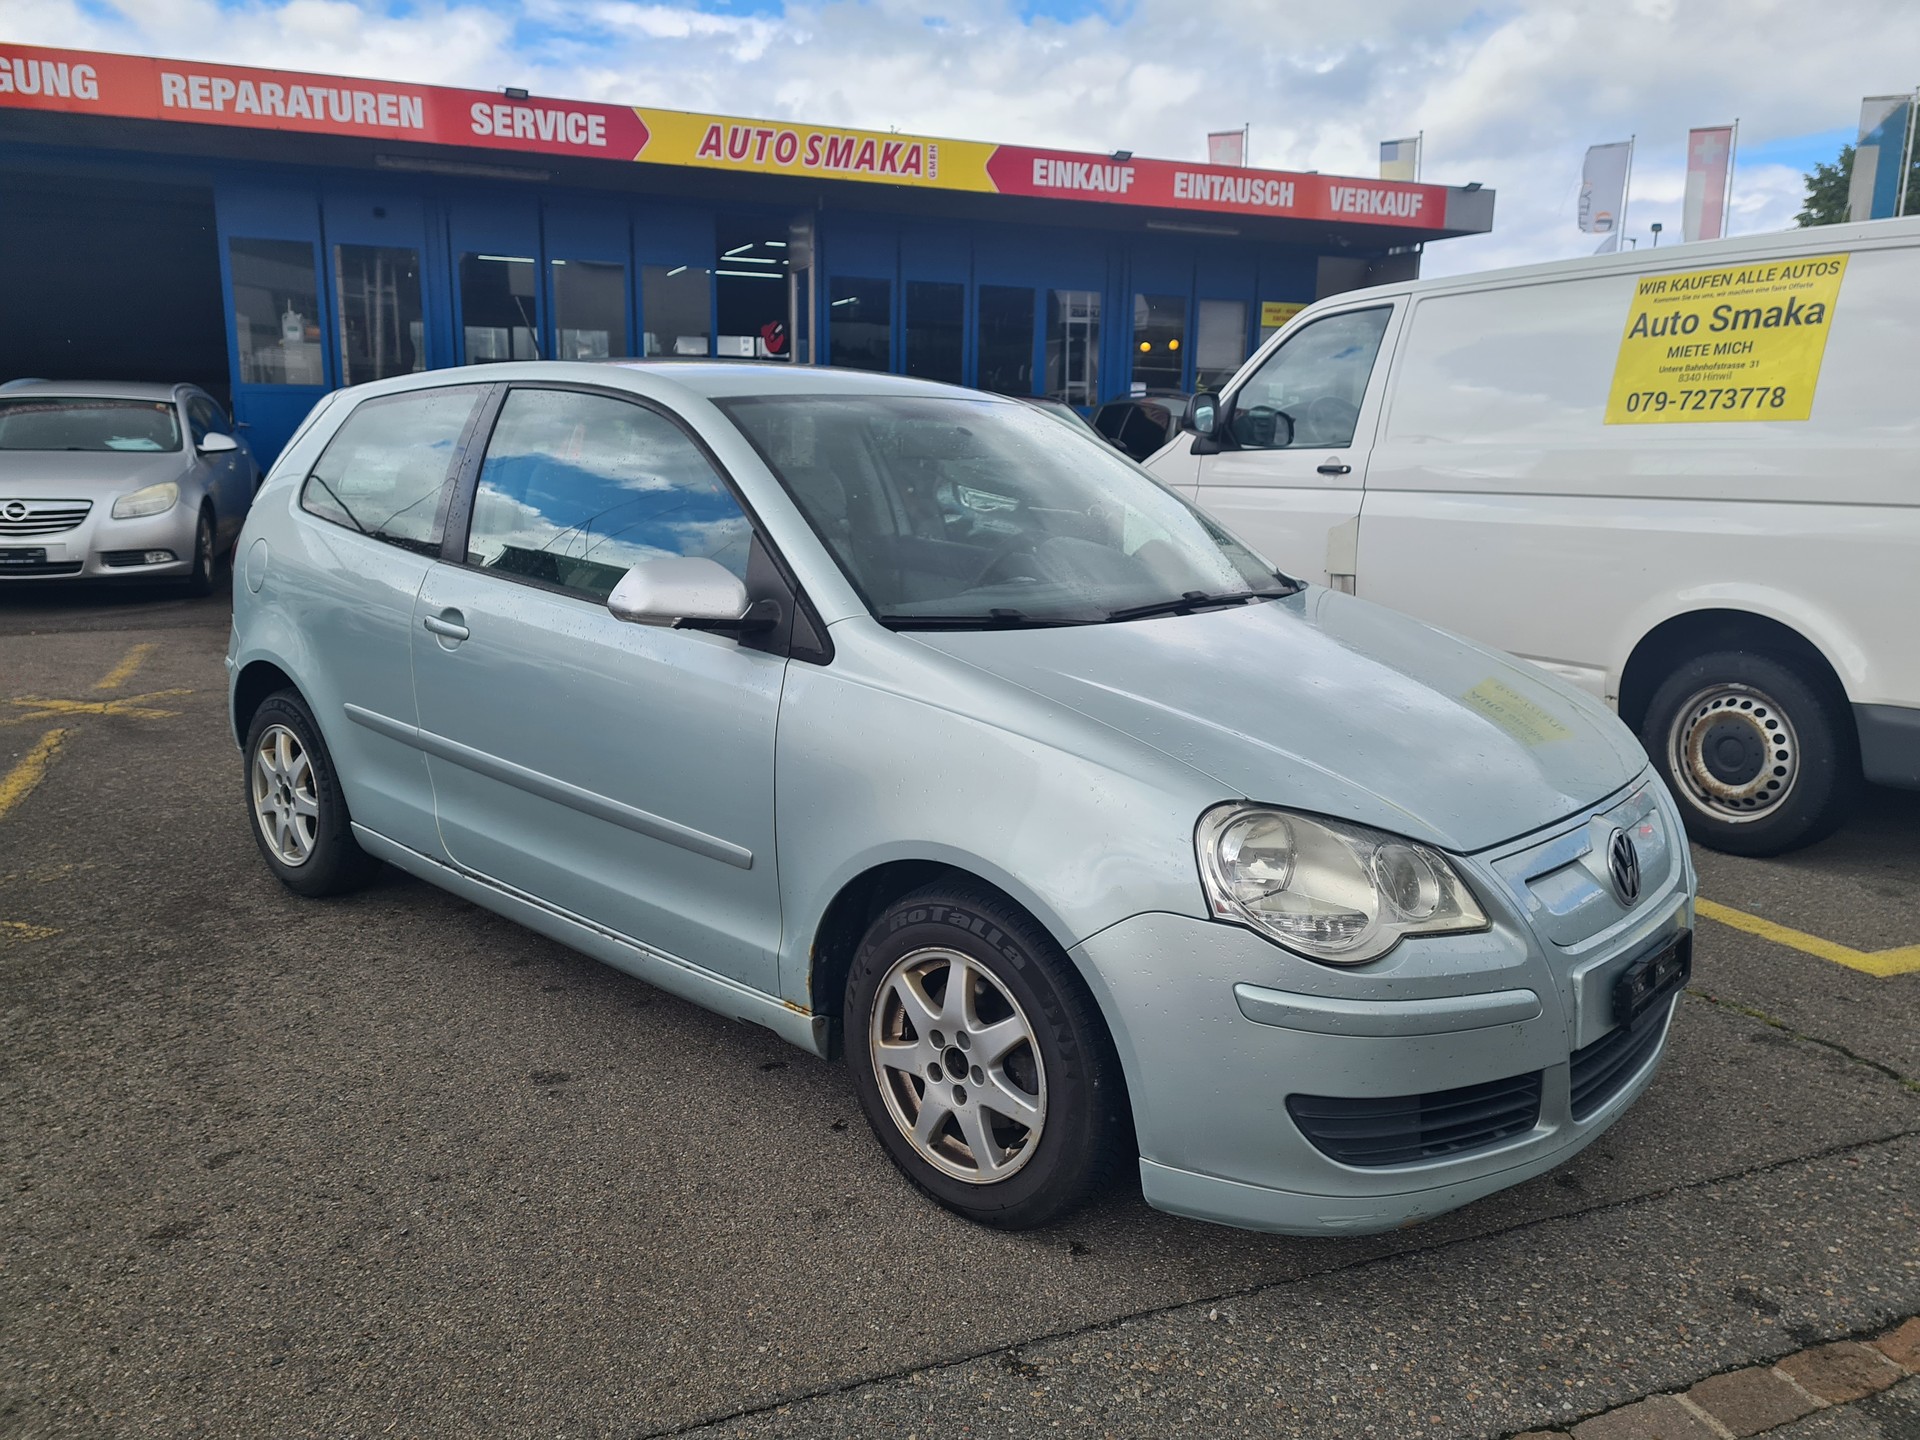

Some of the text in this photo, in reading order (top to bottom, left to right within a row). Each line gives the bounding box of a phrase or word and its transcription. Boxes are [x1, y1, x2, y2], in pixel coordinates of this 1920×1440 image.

[161, 73, 425, 129] REPARATUREN
[470, 102, 607, 146] SERVICE
[698, 125, 923, 176] AUTO SMAKA
[1032, 158, 1423, 218] EINKAUF EINTAUSCH VERKAUF
[1639, 261, 1841, 295] WIR KAUFEN ALLE AUTOS
[1628, 296, 1826, 339] Auto Smaka
[1659, 360, 1760, 373] Untere Bahnhofstrasse 31
[1666, 341, 1754, 359] MIETE MICH
[1678, 371, 1733, 383] 8340 Hinwil
[1626, 386, 1787, 413] 079-7273778
